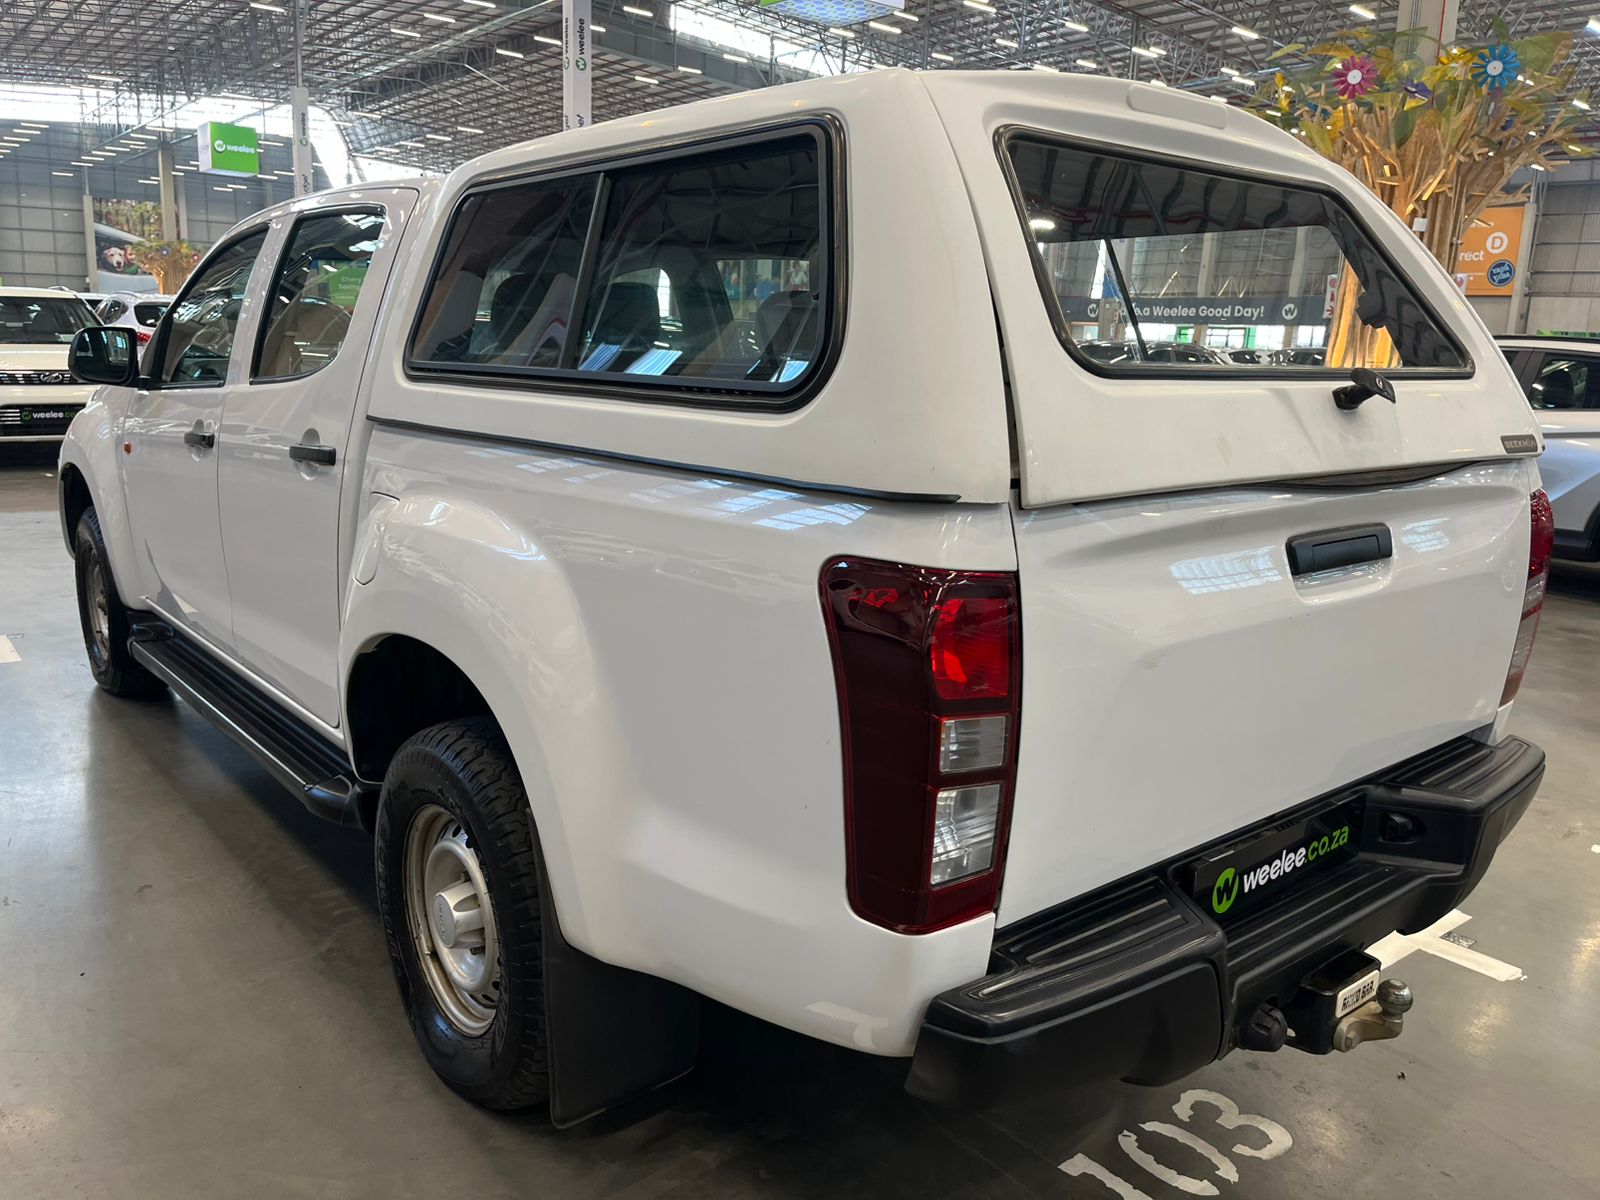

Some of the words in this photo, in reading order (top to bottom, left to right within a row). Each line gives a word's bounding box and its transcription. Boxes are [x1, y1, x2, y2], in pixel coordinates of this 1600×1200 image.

[577, 18, 585, 55] weelee
[226, 144, 255, 154] weelee
[1152, 305, 1196, 317] Weelee
[1199, 305, 1231, 317] Good
[1234, 305, 1264, 320] Day!
[1057, 1089, 1292, 1200] 103
